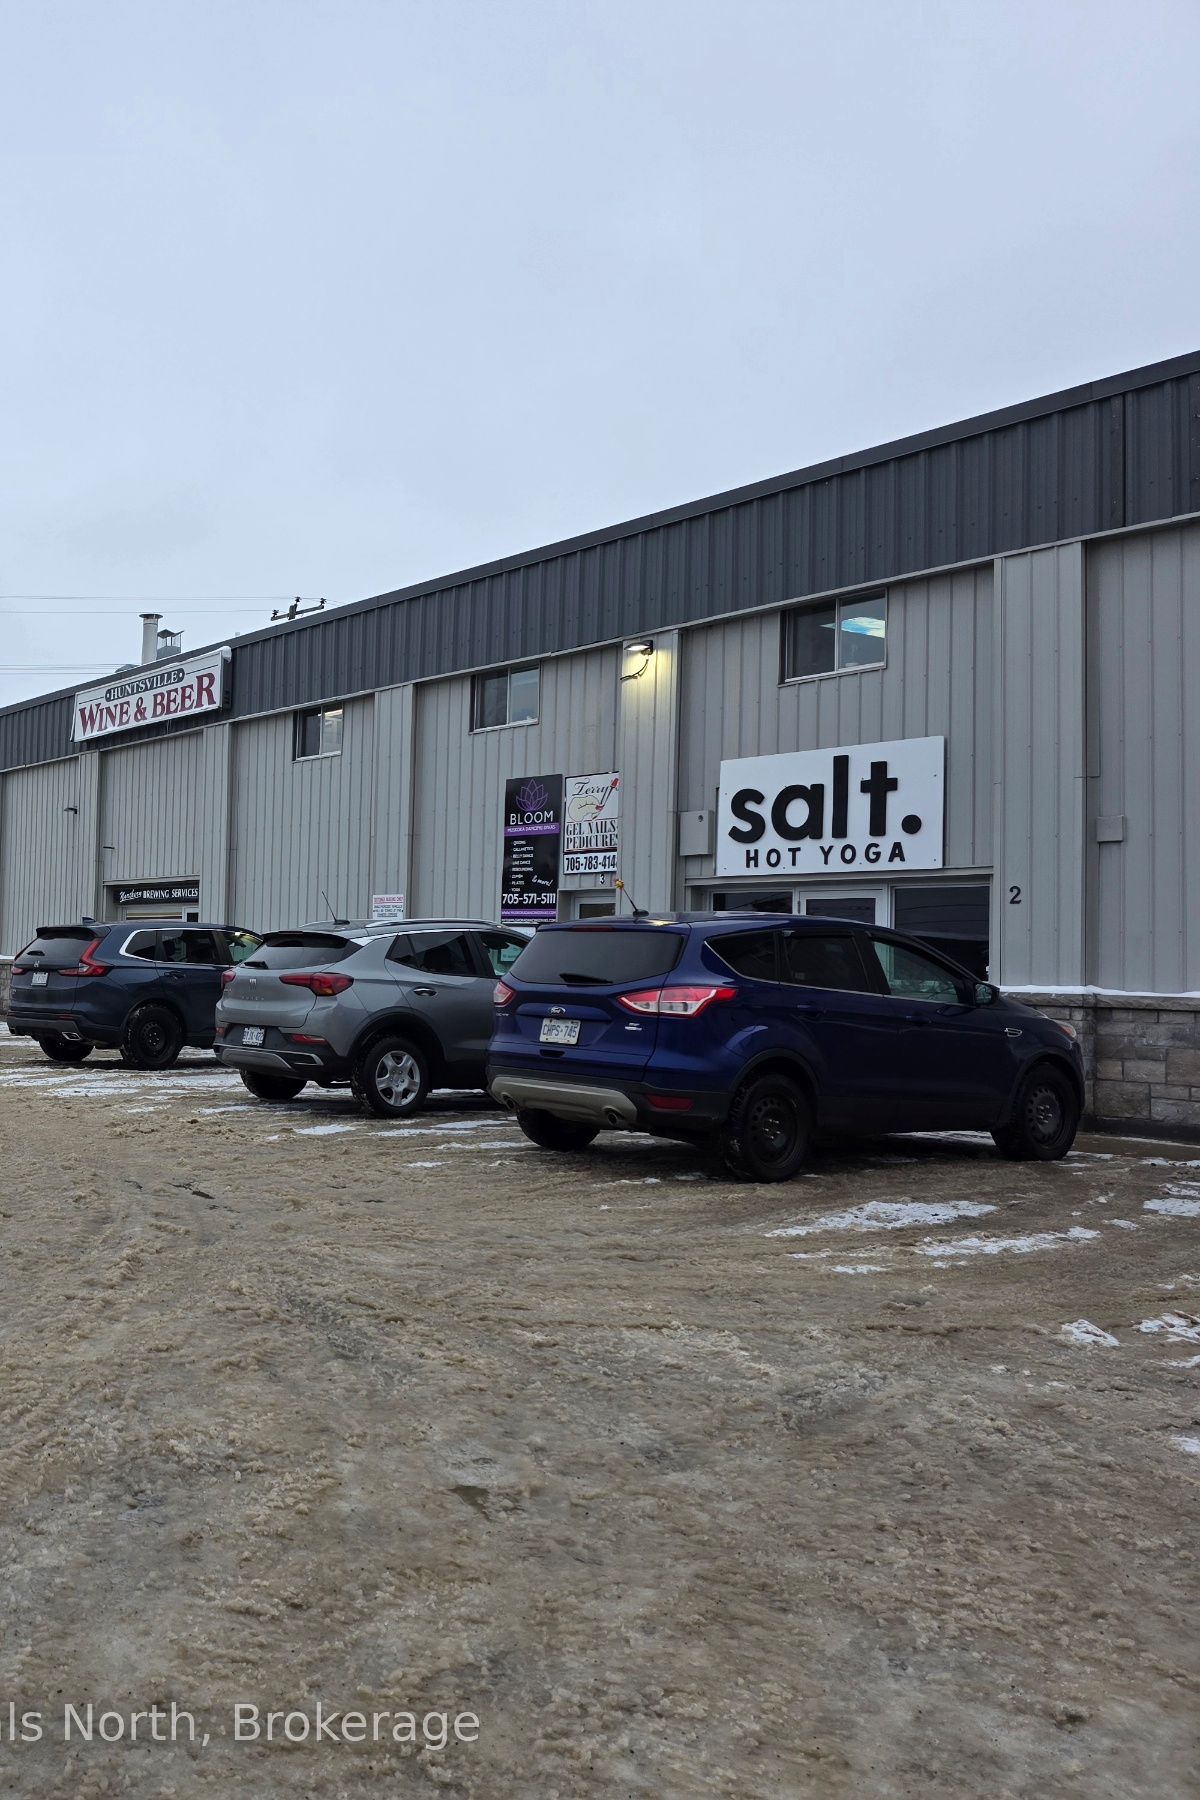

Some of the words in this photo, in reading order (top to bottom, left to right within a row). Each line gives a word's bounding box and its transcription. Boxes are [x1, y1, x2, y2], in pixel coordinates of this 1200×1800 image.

[109, 671, 179, 700] HUNTSVILLE
[78, 700, 131, 736] WINE
[133, 696, 148, 723] &
[151, 672, 217, 719] BEER
[727, 754, 922, 844] salt.
[509, 810, 554, 825] BLOOM
[566, 822, 585, 836] GEL
[565, 854, 618, 871] 705-783-414
[745, 846, 802, 869] HOT
[819, 841, 906, 866] YOGA
[600, 873, 606, 885] 3
[143, 889, 170, 899] BREWING
[171, 887, 199, 898] SERVICES
[502, 893, 556, 904] 705-571-5111
[1008, 885, 1022, 905] 2
